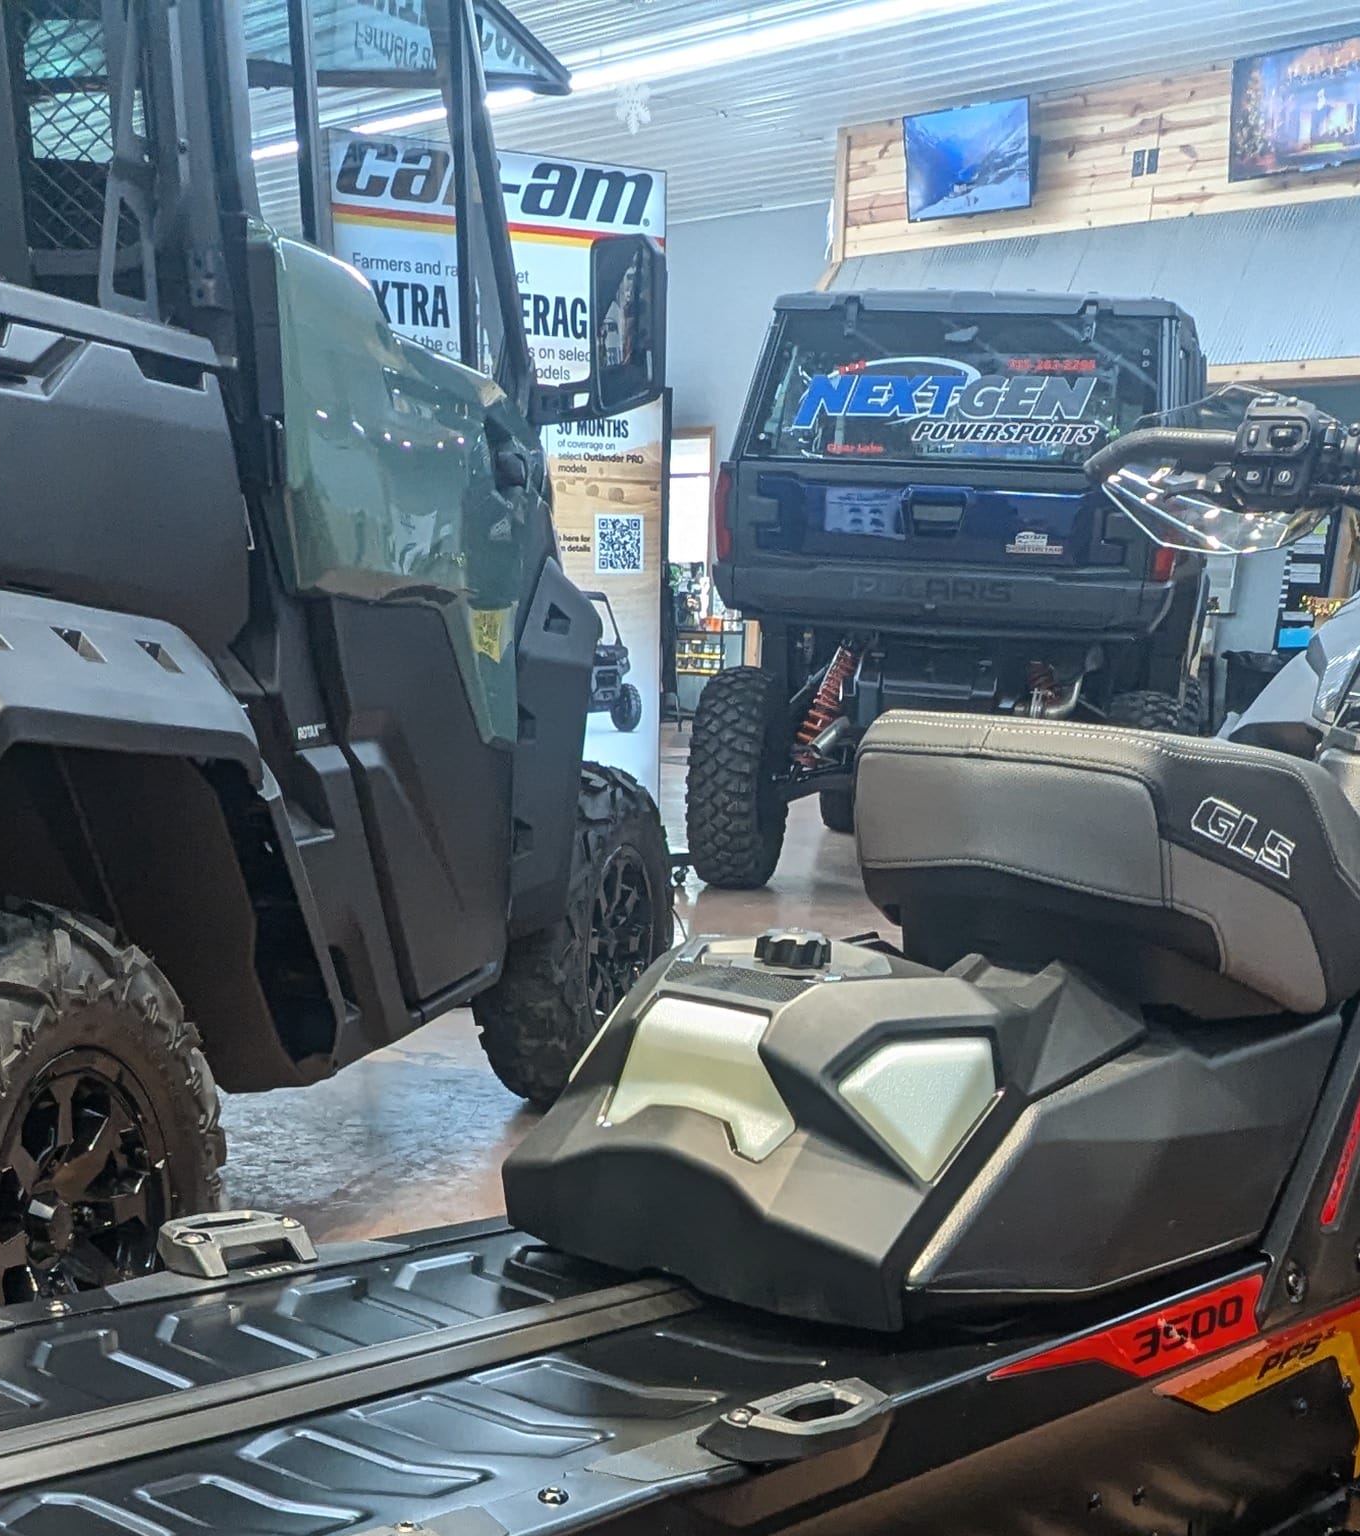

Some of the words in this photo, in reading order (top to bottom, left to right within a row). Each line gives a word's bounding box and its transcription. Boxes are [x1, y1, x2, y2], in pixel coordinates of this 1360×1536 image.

[352, 252, 412, 274] Farmers
[415, 255, 441, 276] and
[372, 279, 452, 329] XTRA
[539, 347, 556, 360] on
[536, 366, 571, 381] odels
[911, 421, 1100, 446] POWERSPORTS
[557, 438, 567, 448] of
[566, 439, 604, 451] coverage
[605, 442, 616, 450] on
[583, 453, 625, 463] Outlander
[625, 454, 644, 464] PRO
[557, 464, 587, 474] models
[1190, 796, 1296, 879] GLS
[1131, 1295, 1244, 1366] 3500
